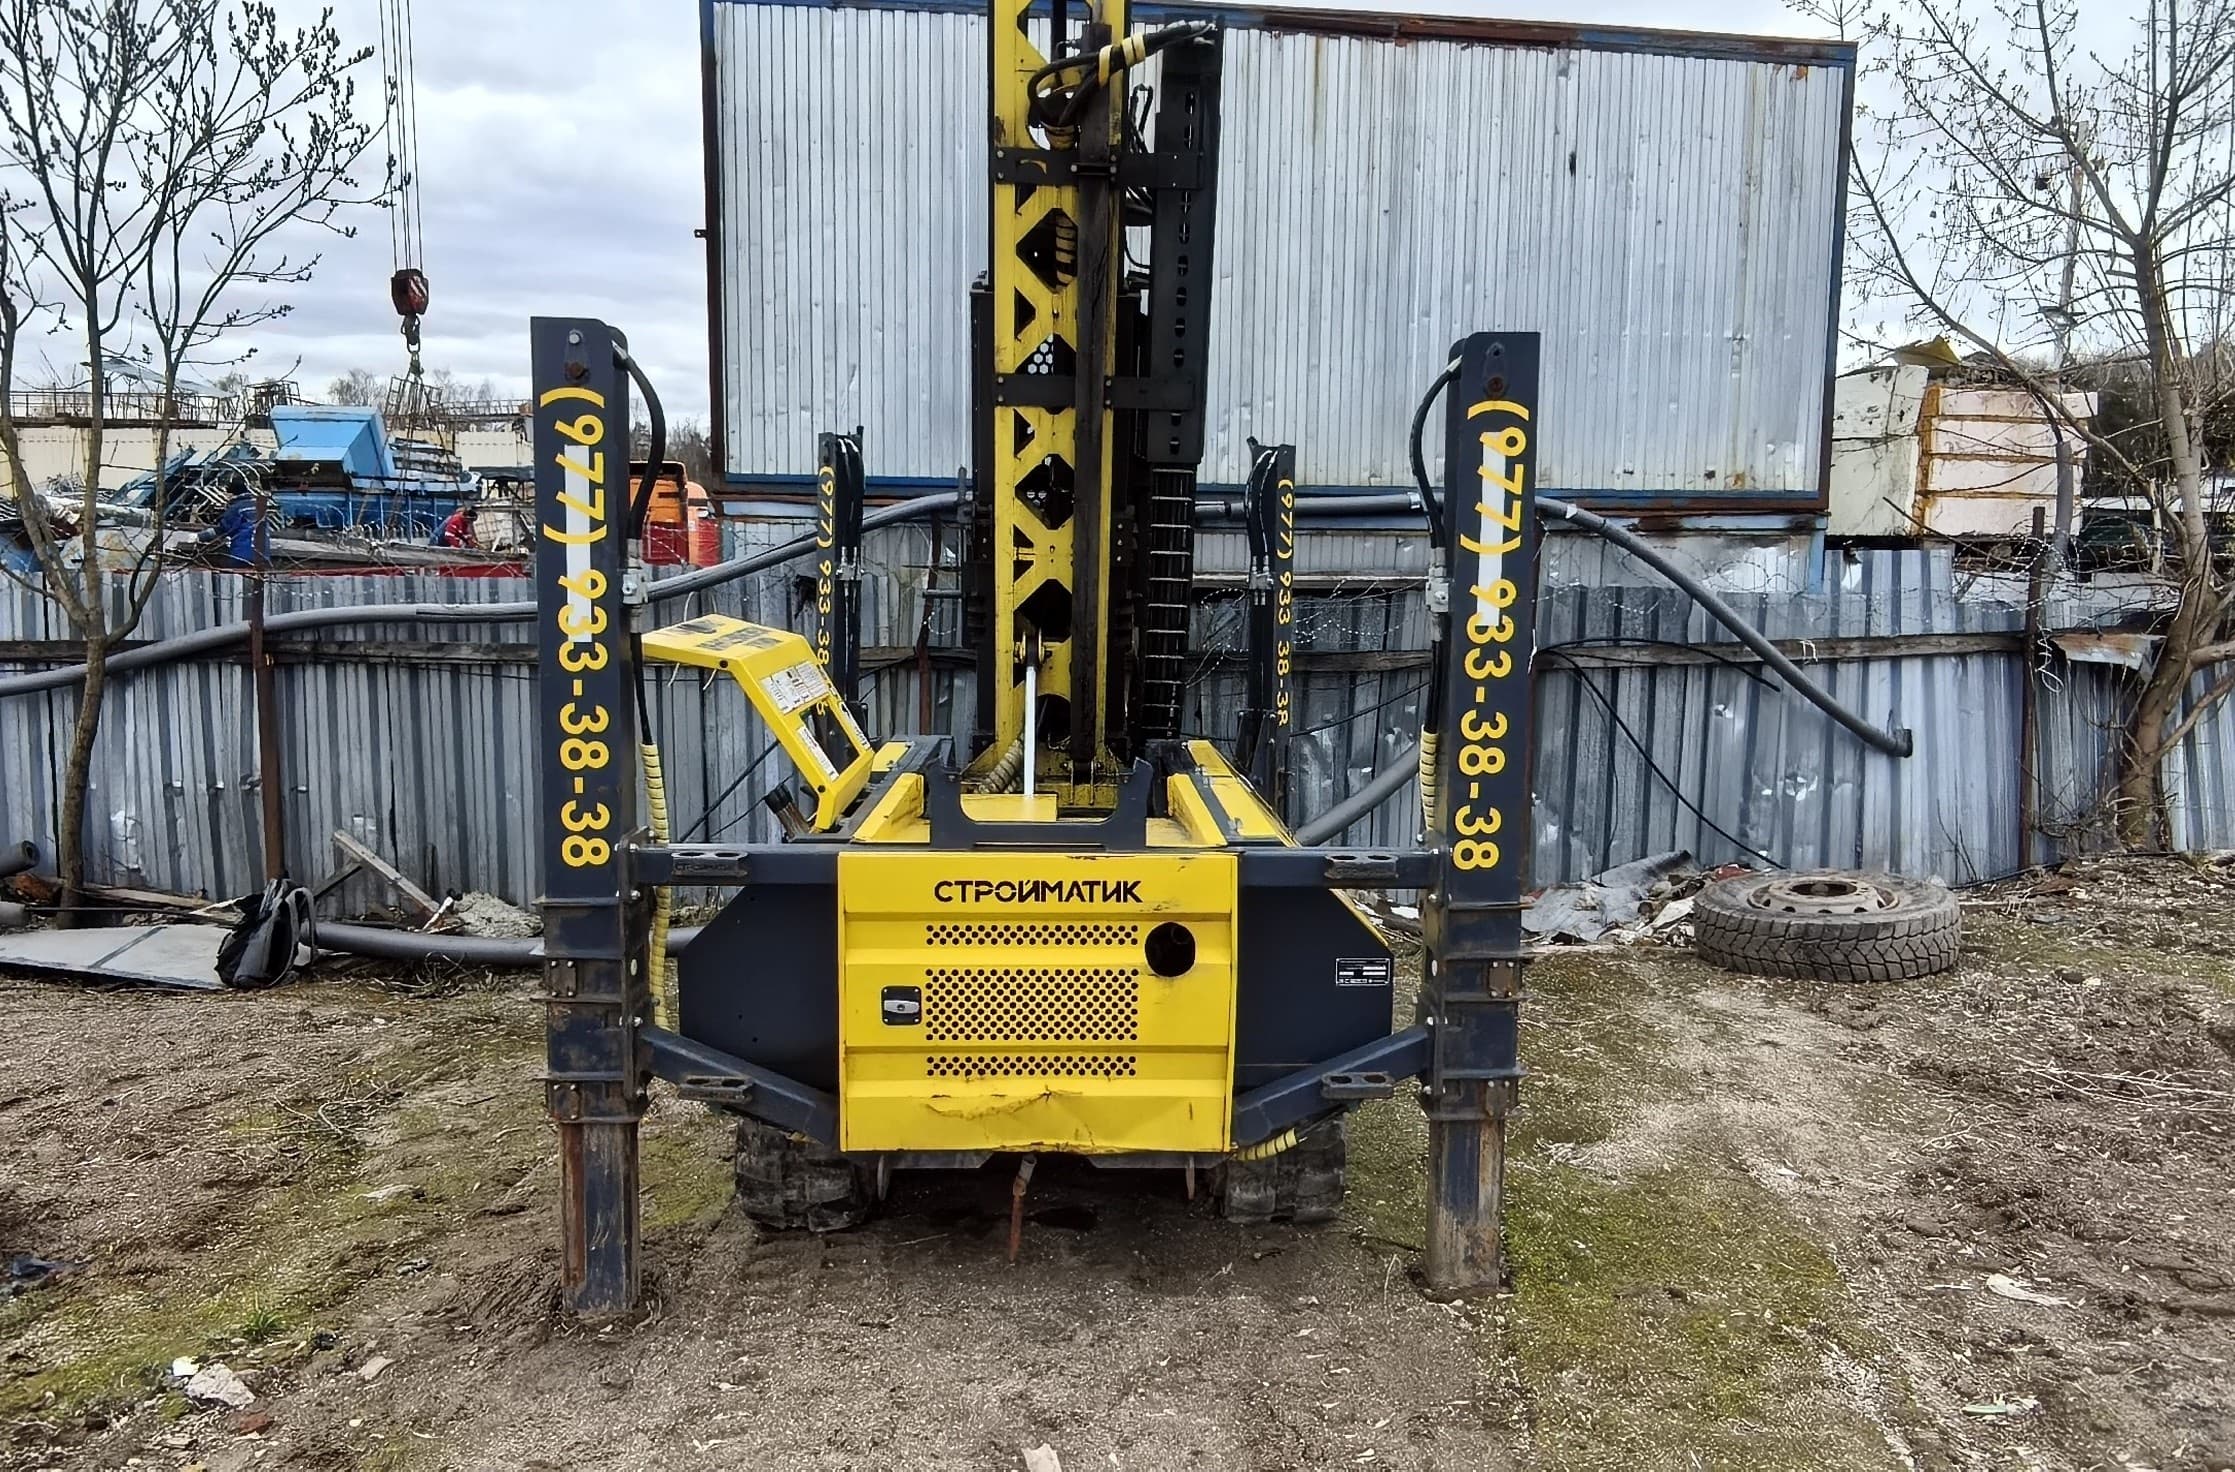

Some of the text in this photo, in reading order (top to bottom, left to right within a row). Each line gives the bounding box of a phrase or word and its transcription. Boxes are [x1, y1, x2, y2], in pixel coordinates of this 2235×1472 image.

[817, 466, 835, 548] (977)
[1277, 479, 1293, 560] (977)
[541, 387, 610, 868] (977) 933-38-38
[1453, 400, 1529, 870] (977) 933-38-38
[935, 879, 1142, 902] СТРОЙМАТИК
